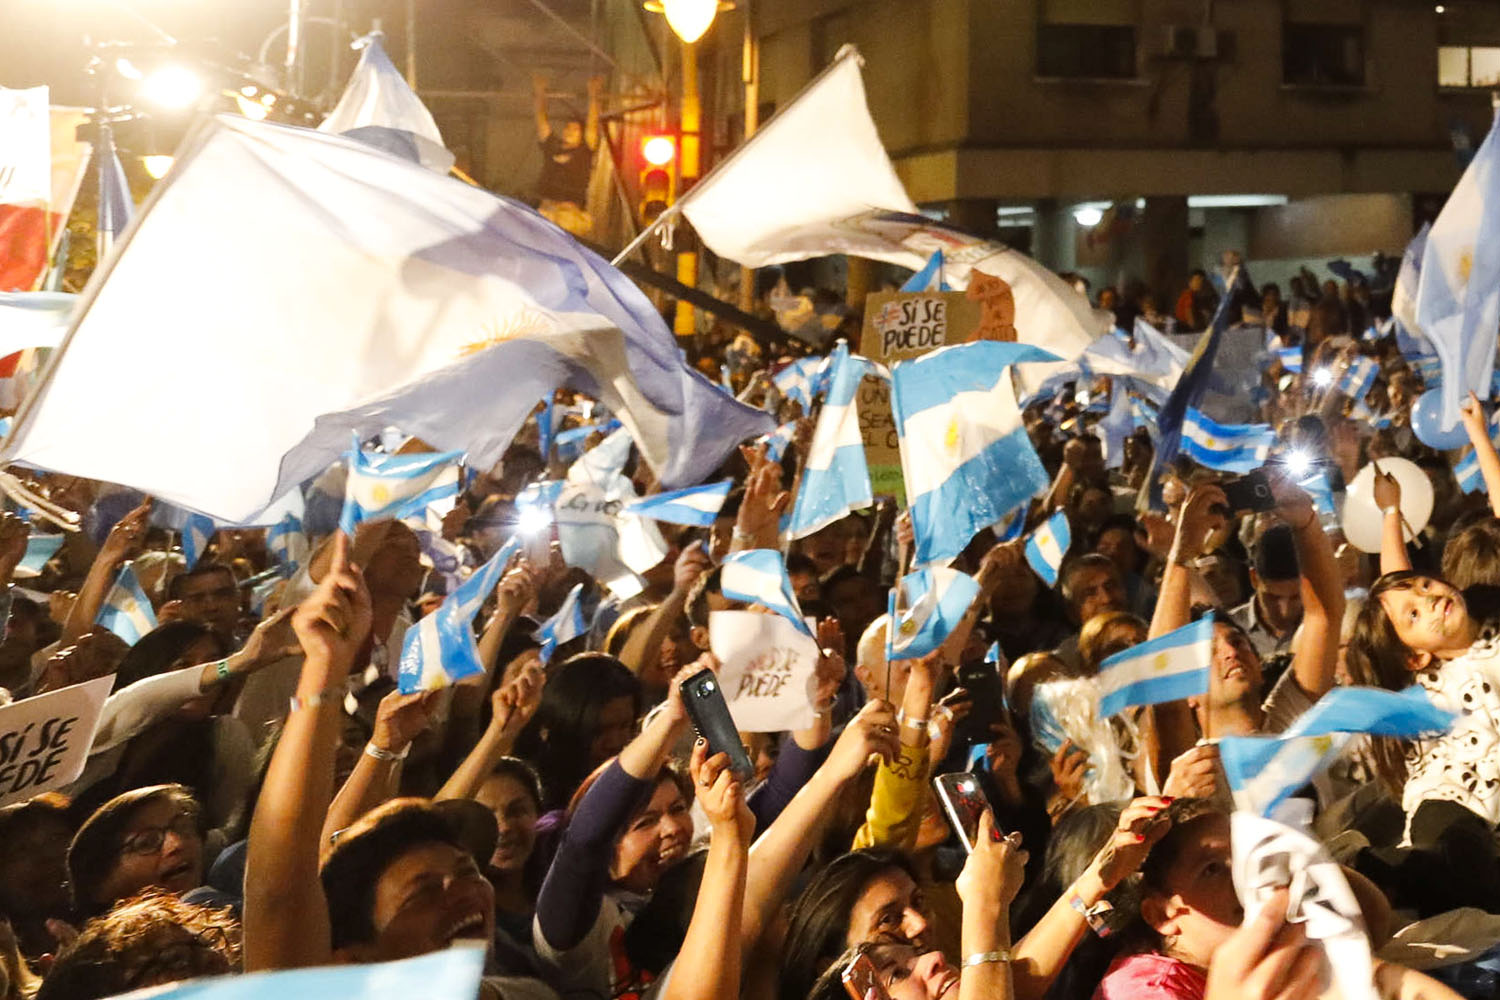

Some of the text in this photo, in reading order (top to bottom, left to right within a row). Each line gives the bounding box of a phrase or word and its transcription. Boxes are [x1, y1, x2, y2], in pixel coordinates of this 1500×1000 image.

[922, 299, 945, 323] SE
[883, 324, 945, 356] PUEDE
[28, 716, 79, 758] SE
